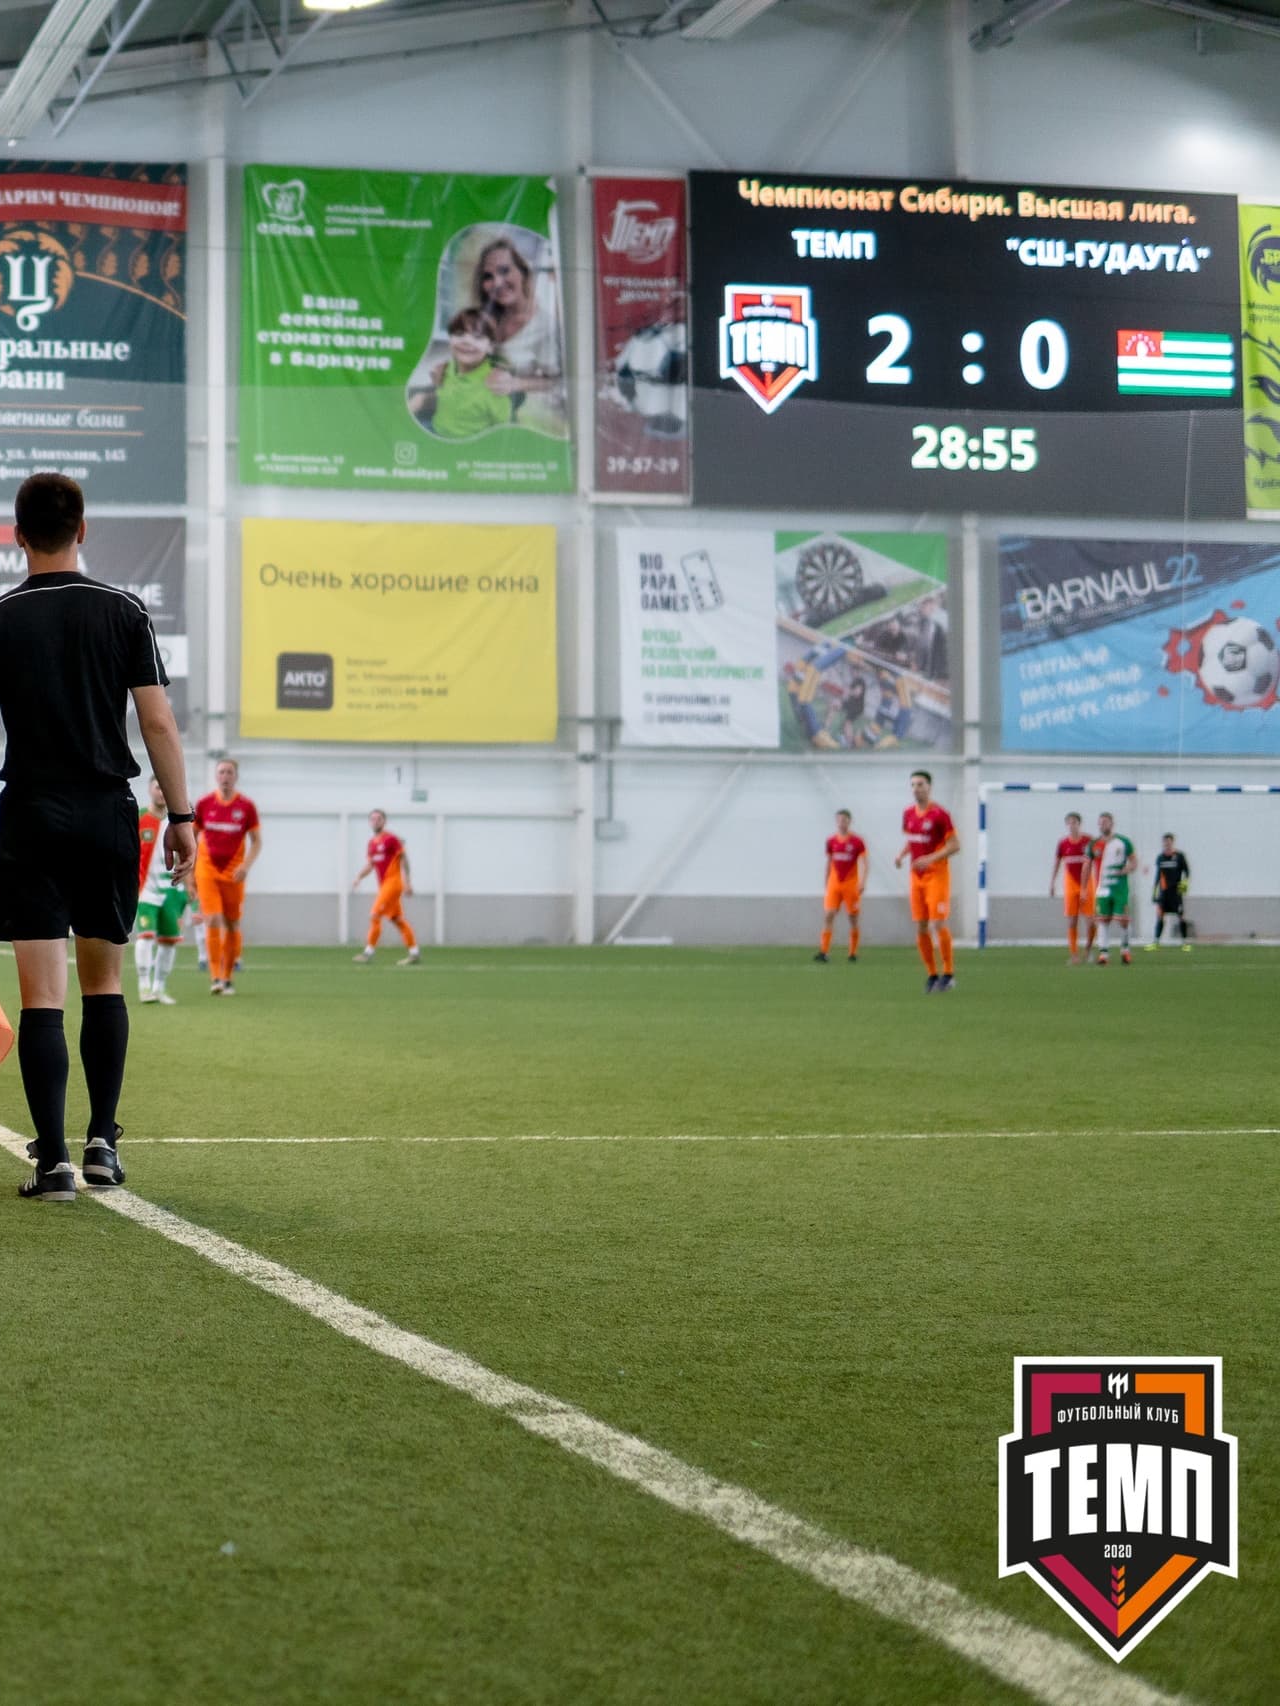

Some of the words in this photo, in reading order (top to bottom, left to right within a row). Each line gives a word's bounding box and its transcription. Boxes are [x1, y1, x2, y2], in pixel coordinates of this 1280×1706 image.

[737, 180, 895, 212] Чемпионат
[899, 187, 1012, 221] Сибири.
[1018, 192, 1124, 222] Высшая
[1129, 202, 1197, 225] лига.
[791, 228, 877, 261] ТЕМП
[302, 294, 359, 312] Ваша
[866, 313, 913, 385] 2
[1019, 318, 1069, 390] 0
[76, 409, 127, 428] бани
[910, 424, 1038, 472] 28:55
[259, 564, 342, 589] Очень
[351, 571, 469, 596] хорошие
[477, 574, 539, 593] окна
